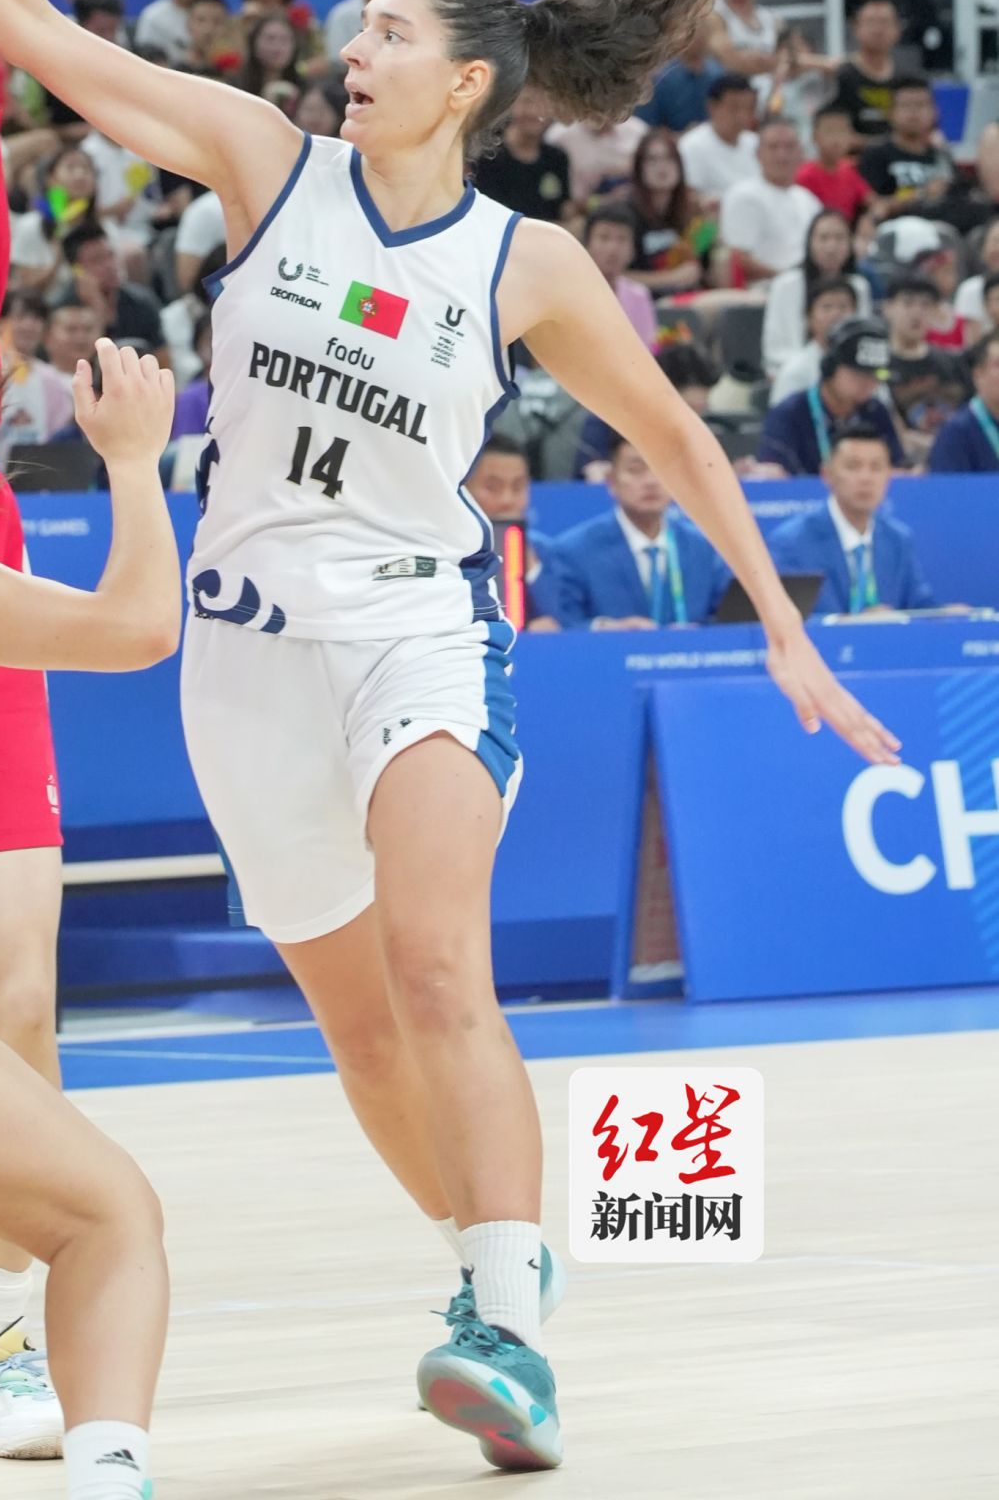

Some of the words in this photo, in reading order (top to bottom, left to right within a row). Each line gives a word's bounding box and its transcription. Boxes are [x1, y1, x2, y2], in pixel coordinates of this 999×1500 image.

[325, 336, 376, 371] fadu
[248, 341, 428, 445] PORTUGAL
[286, 426, 351, 500] 14
